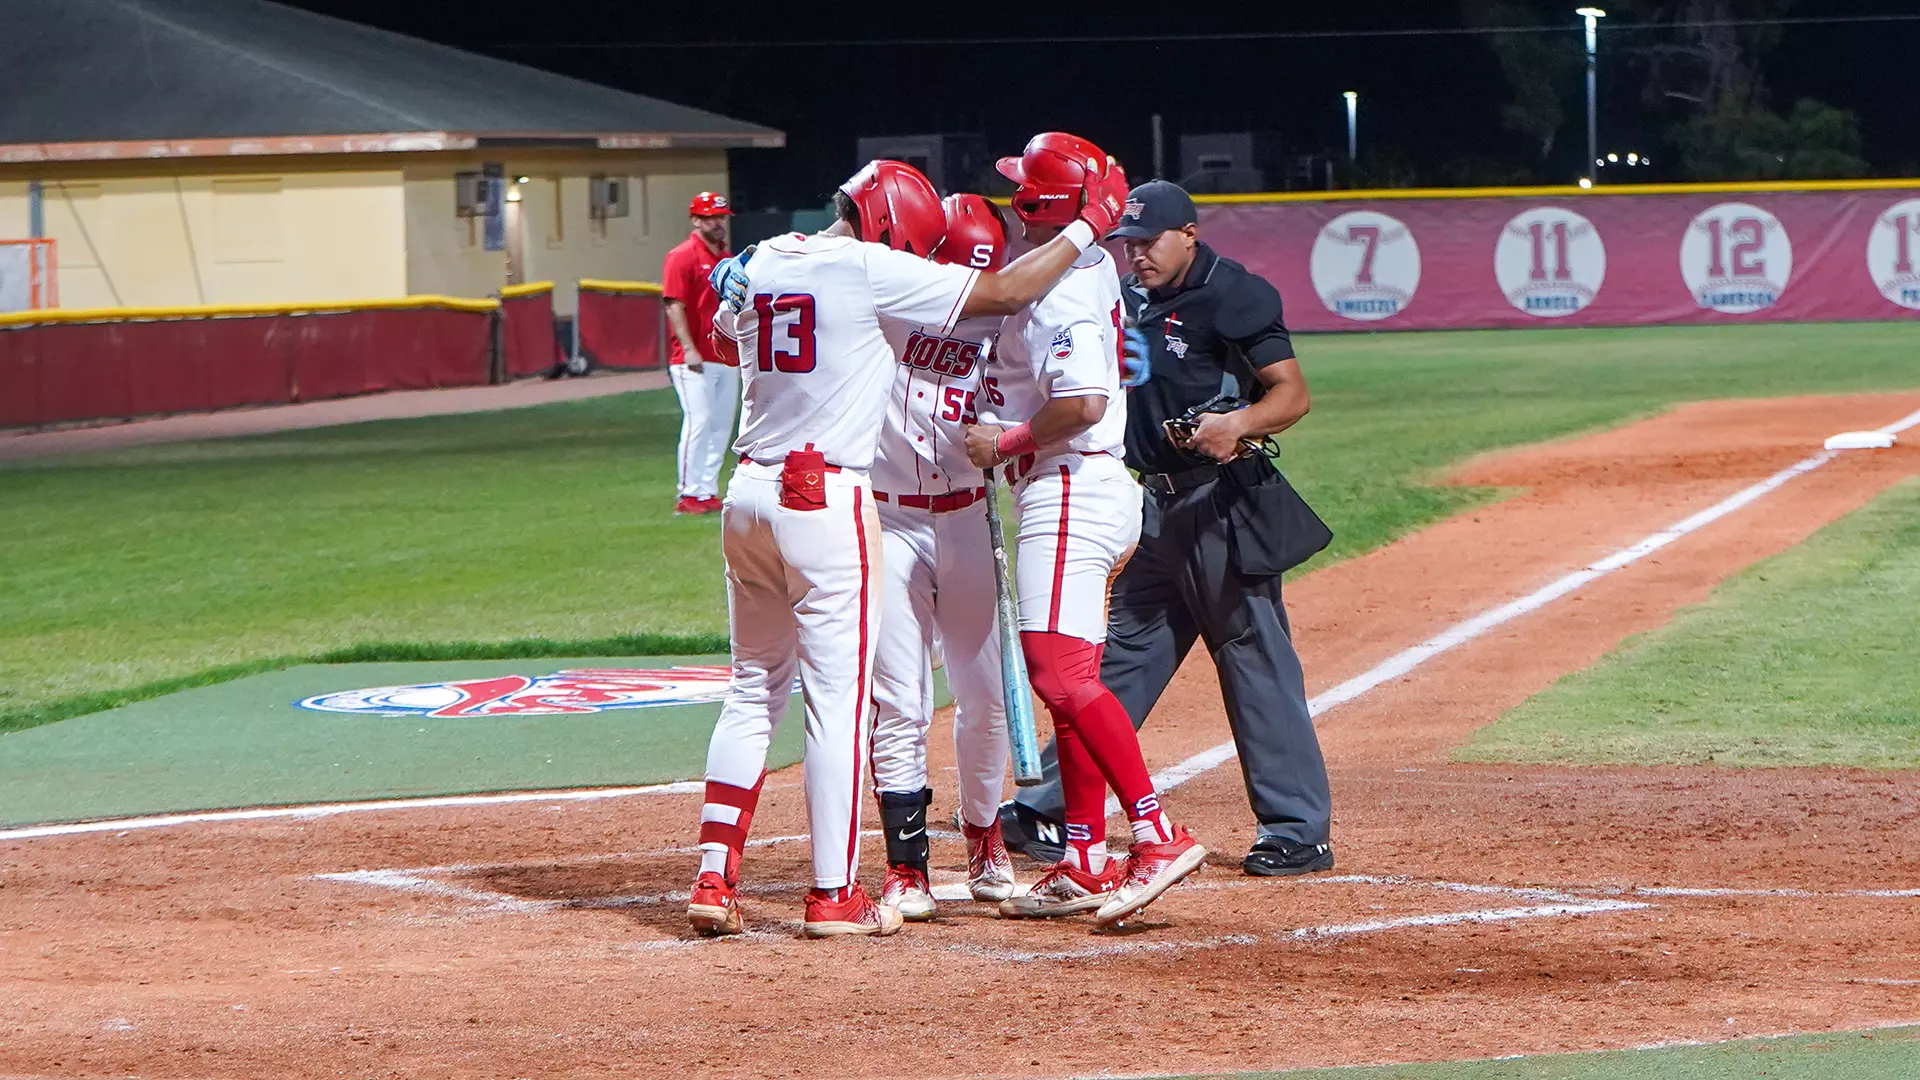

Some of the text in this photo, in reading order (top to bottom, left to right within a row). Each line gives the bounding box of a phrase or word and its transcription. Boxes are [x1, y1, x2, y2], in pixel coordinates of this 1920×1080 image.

[970, 244, 994, 268] S
[1347, 225, 1381, 286] 7
[1528, 220, 1571, 280] 11
[1707, 216, 1765, 279] 12
[753, 293, 816, 373] 13
[1135, 793, 1160, 817] S
[1036, 820, 1061, 844] N
[1066, 823, 1092, 841] S
